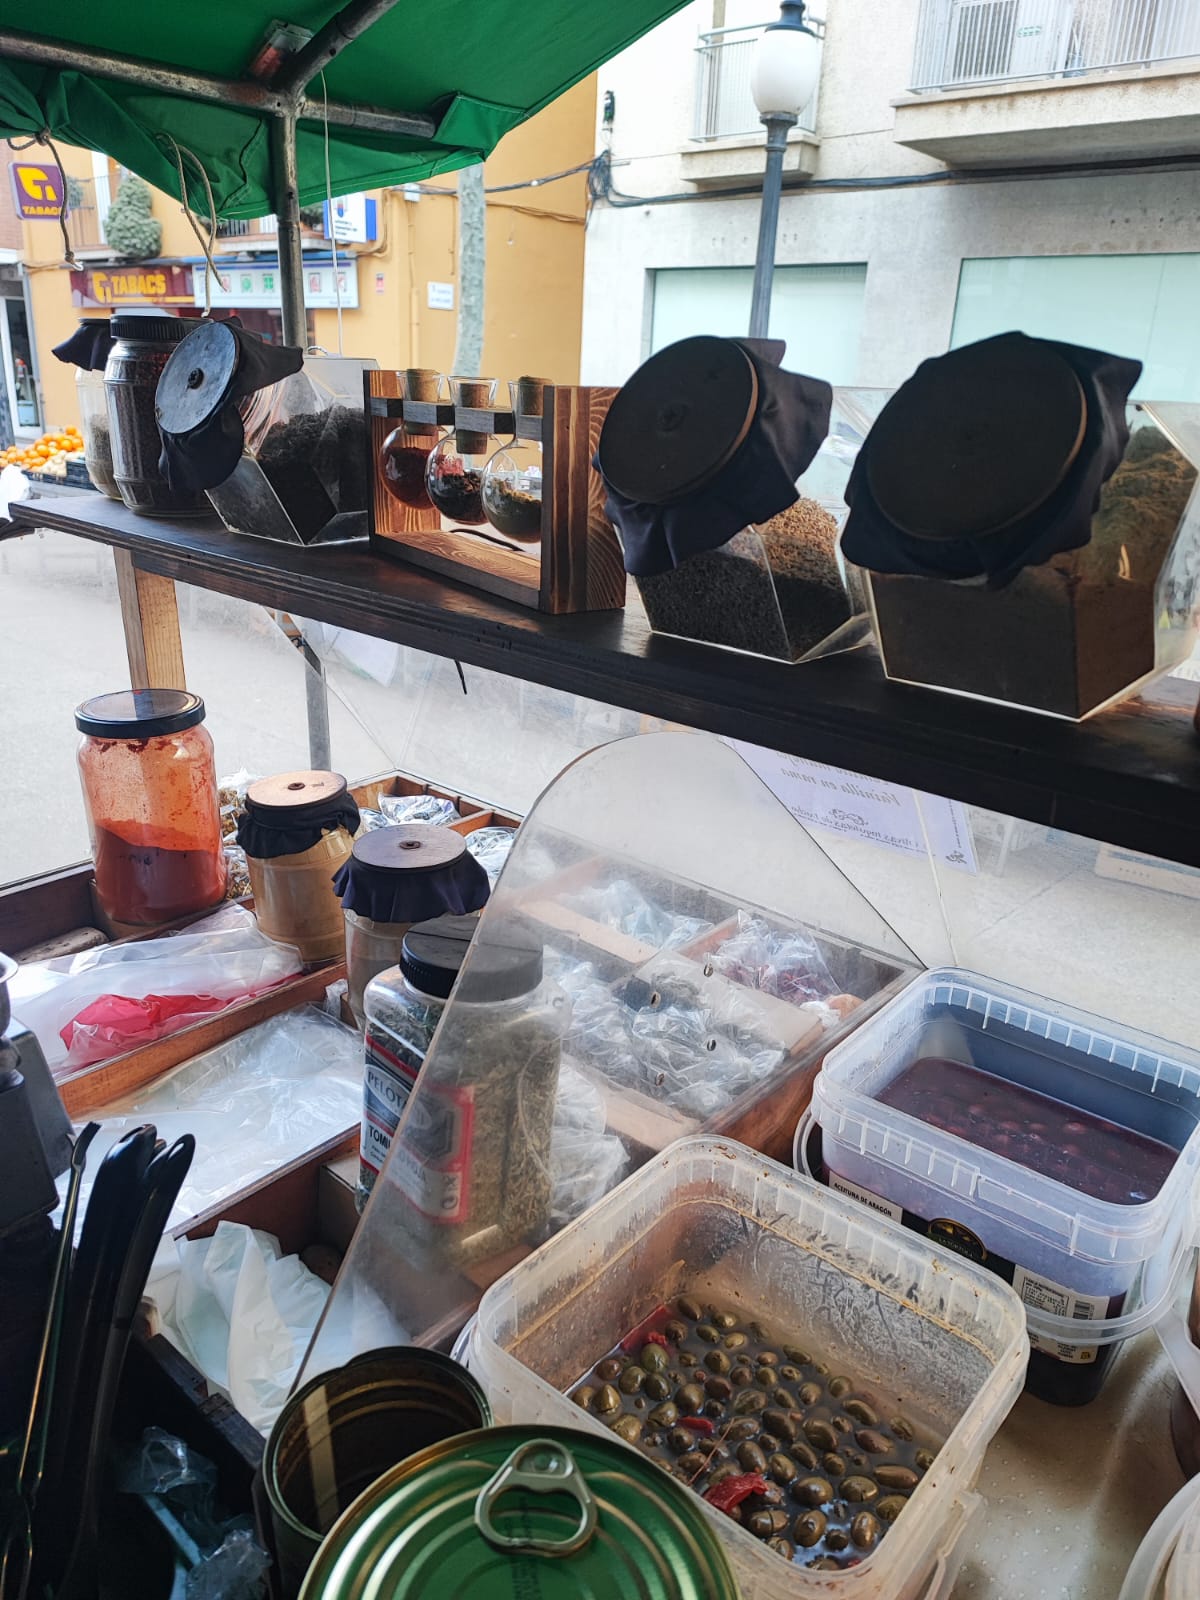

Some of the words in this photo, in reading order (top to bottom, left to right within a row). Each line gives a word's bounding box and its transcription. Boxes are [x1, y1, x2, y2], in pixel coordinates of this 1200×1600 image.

[22, 205, 61, 216] TABAC
[110, 274, 167, 295] TABACS
[834, 1182, 860, 1201] ACEITUNA
[860, 1196, 868, 1205] DE
